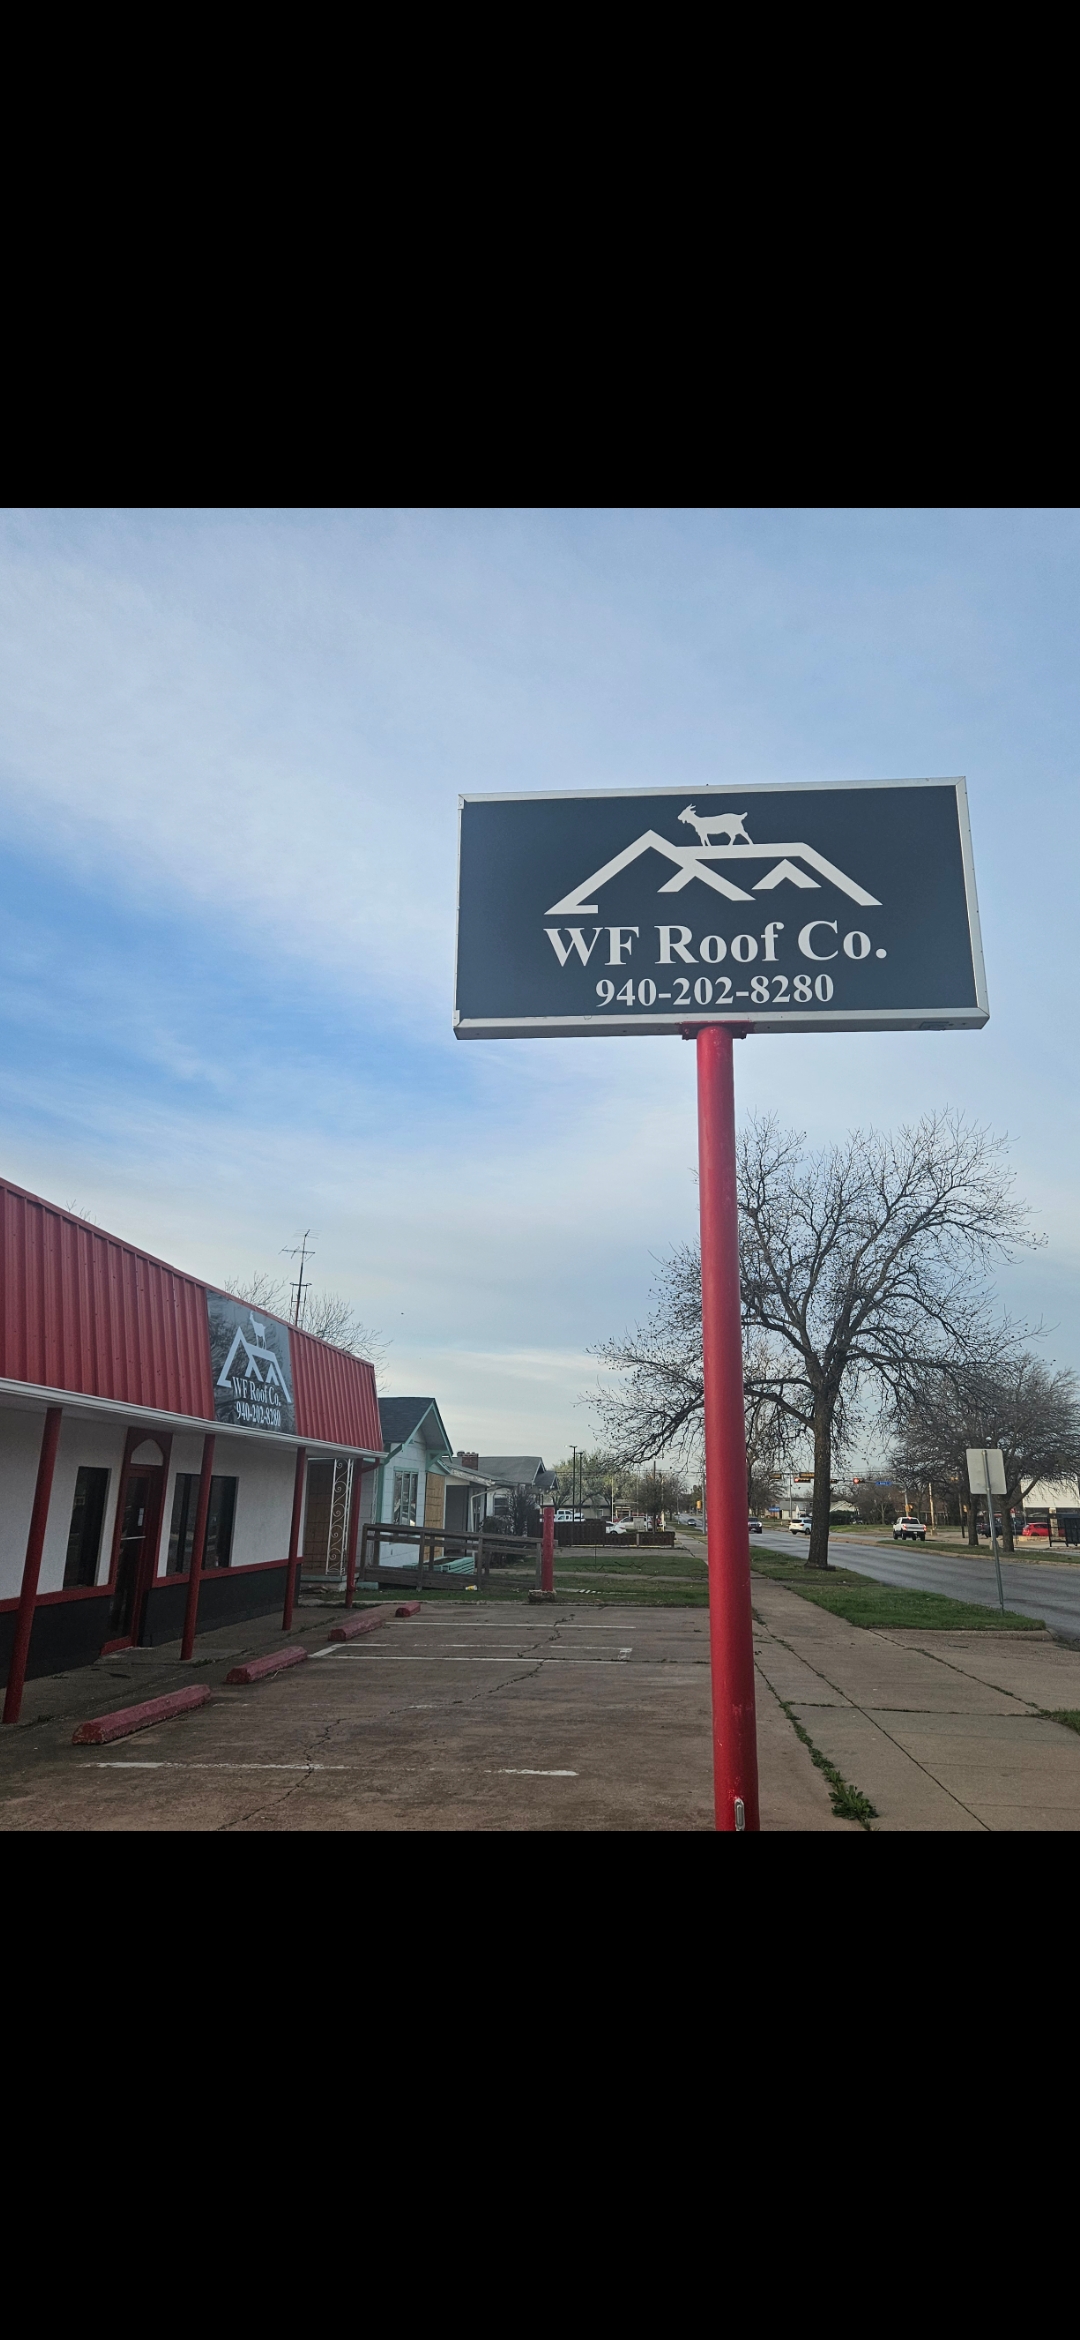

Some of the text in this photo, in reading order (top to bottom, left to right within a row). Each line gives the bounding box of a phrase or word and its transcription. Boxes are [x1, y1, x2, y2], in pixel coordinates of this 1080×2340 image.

[543, 919, 887, 967] WF Roof Co.
[595, 973, 834, 1007] 940-202-8280
[232, 1376, 281, 1407] WF Roof Co.
[236, 1400, 281, 1427] 940-202-8280
